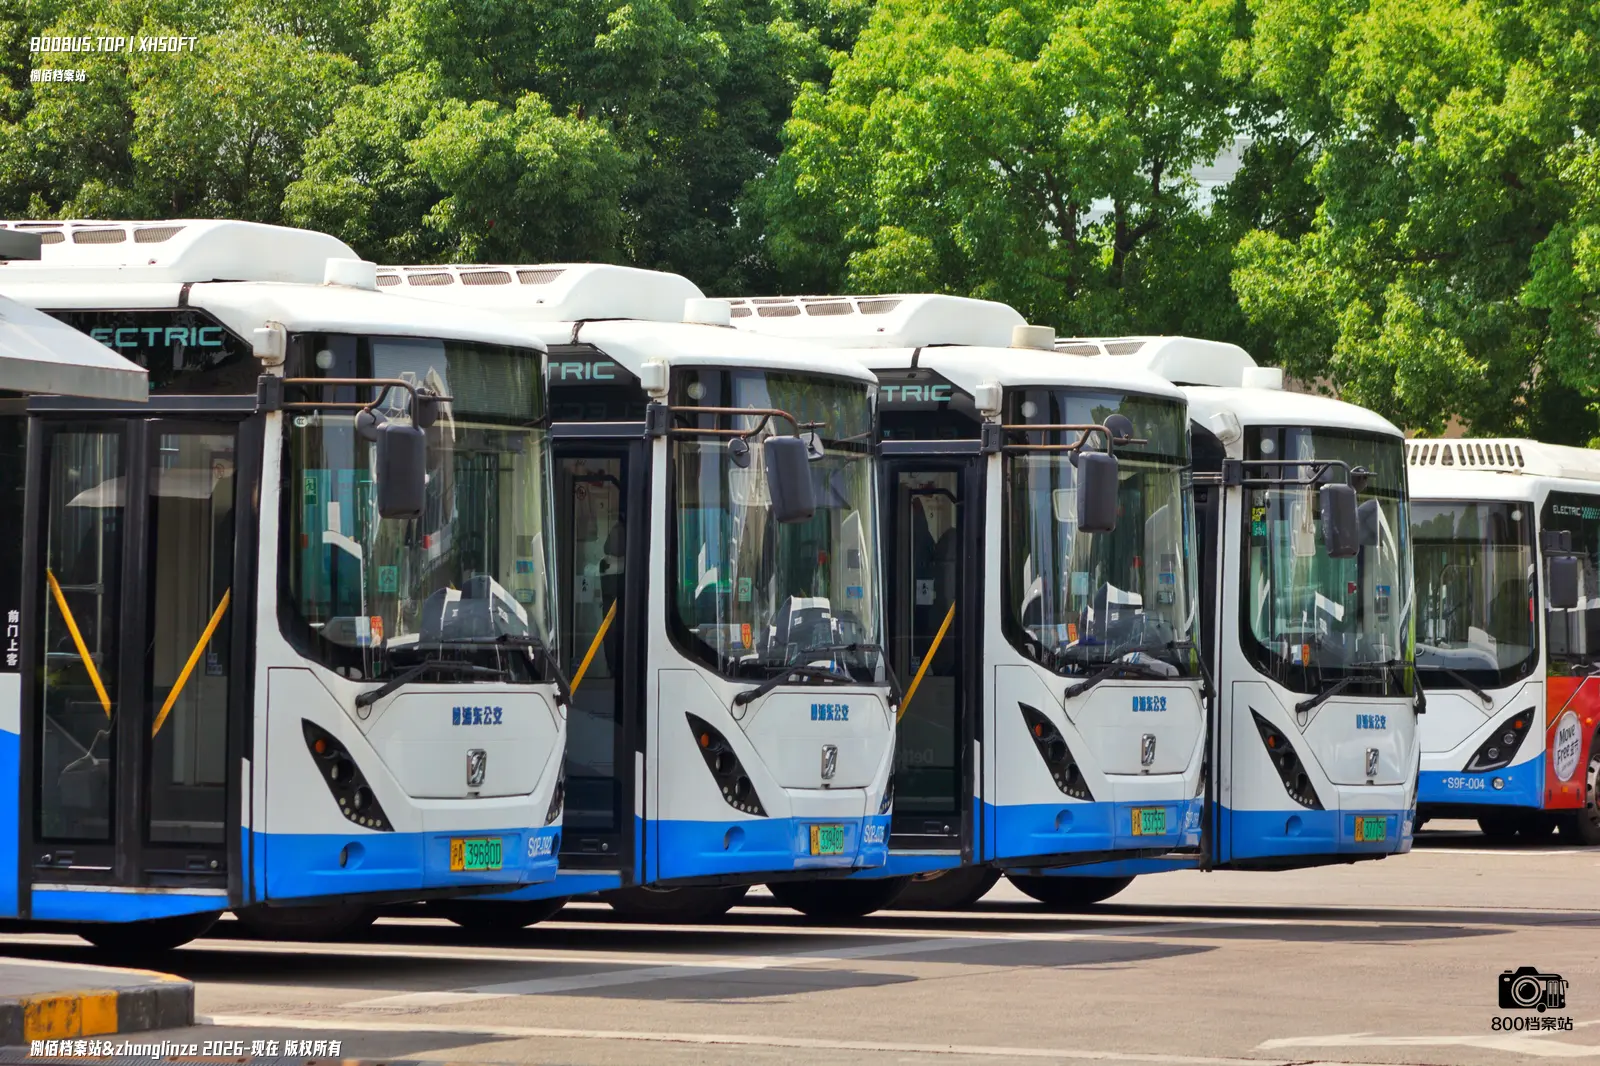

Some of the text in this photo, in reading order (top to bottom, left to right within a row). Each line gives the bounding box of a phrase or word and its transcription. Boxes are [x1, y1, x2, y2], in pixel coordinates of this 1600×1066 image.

[881, 384, 952, 402] TRIC
[1552, 504, 1582, 517] ELECTRIC
[6, 609, 20, 667] 前门上客
[1559, 724, 1576, 745] Move
[1447, 776, 1486, 790] S9F-004
